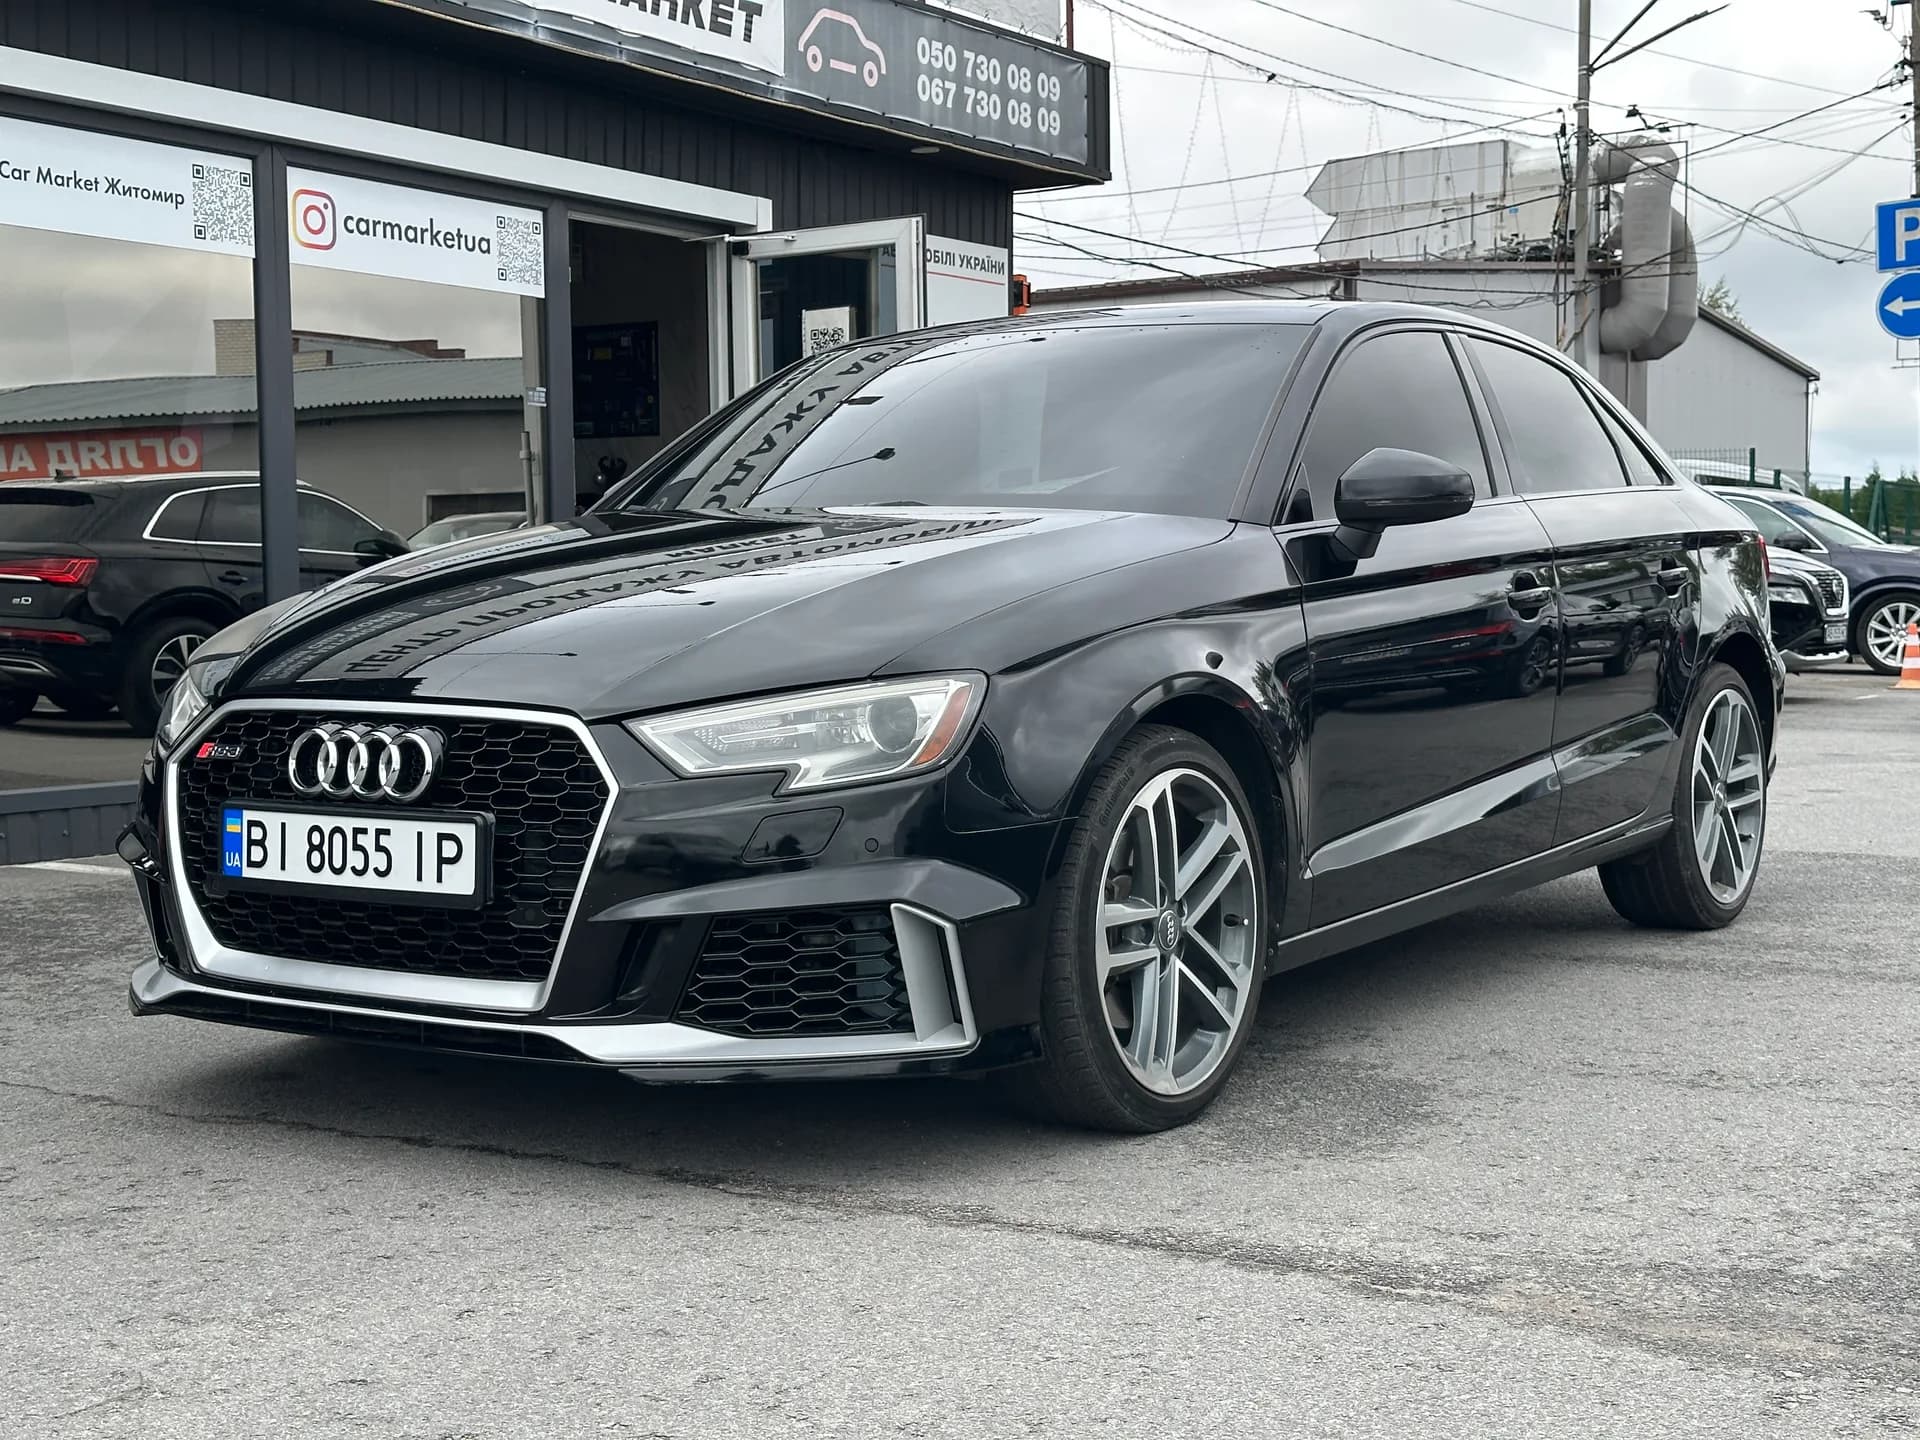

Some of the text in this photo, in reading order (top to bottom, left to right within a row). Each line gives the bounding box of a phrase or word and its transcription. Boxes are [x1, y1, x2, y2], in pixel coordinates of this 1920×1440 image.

[916, 36, 1061, 102] 050 730 08 09
[916, 74, 1061, 136] 067 730 08 09
[0, 160, 185, 209] Car Market Житомир
[343, 214, 491, 255] carmarketua
[1895, 206, 1920, 262] P
[958, 253, 1005, 276] УКРАЇНИ
[225, 851, 241, 866] UA
[246, 819, 464, 884] BI 8055 IP
